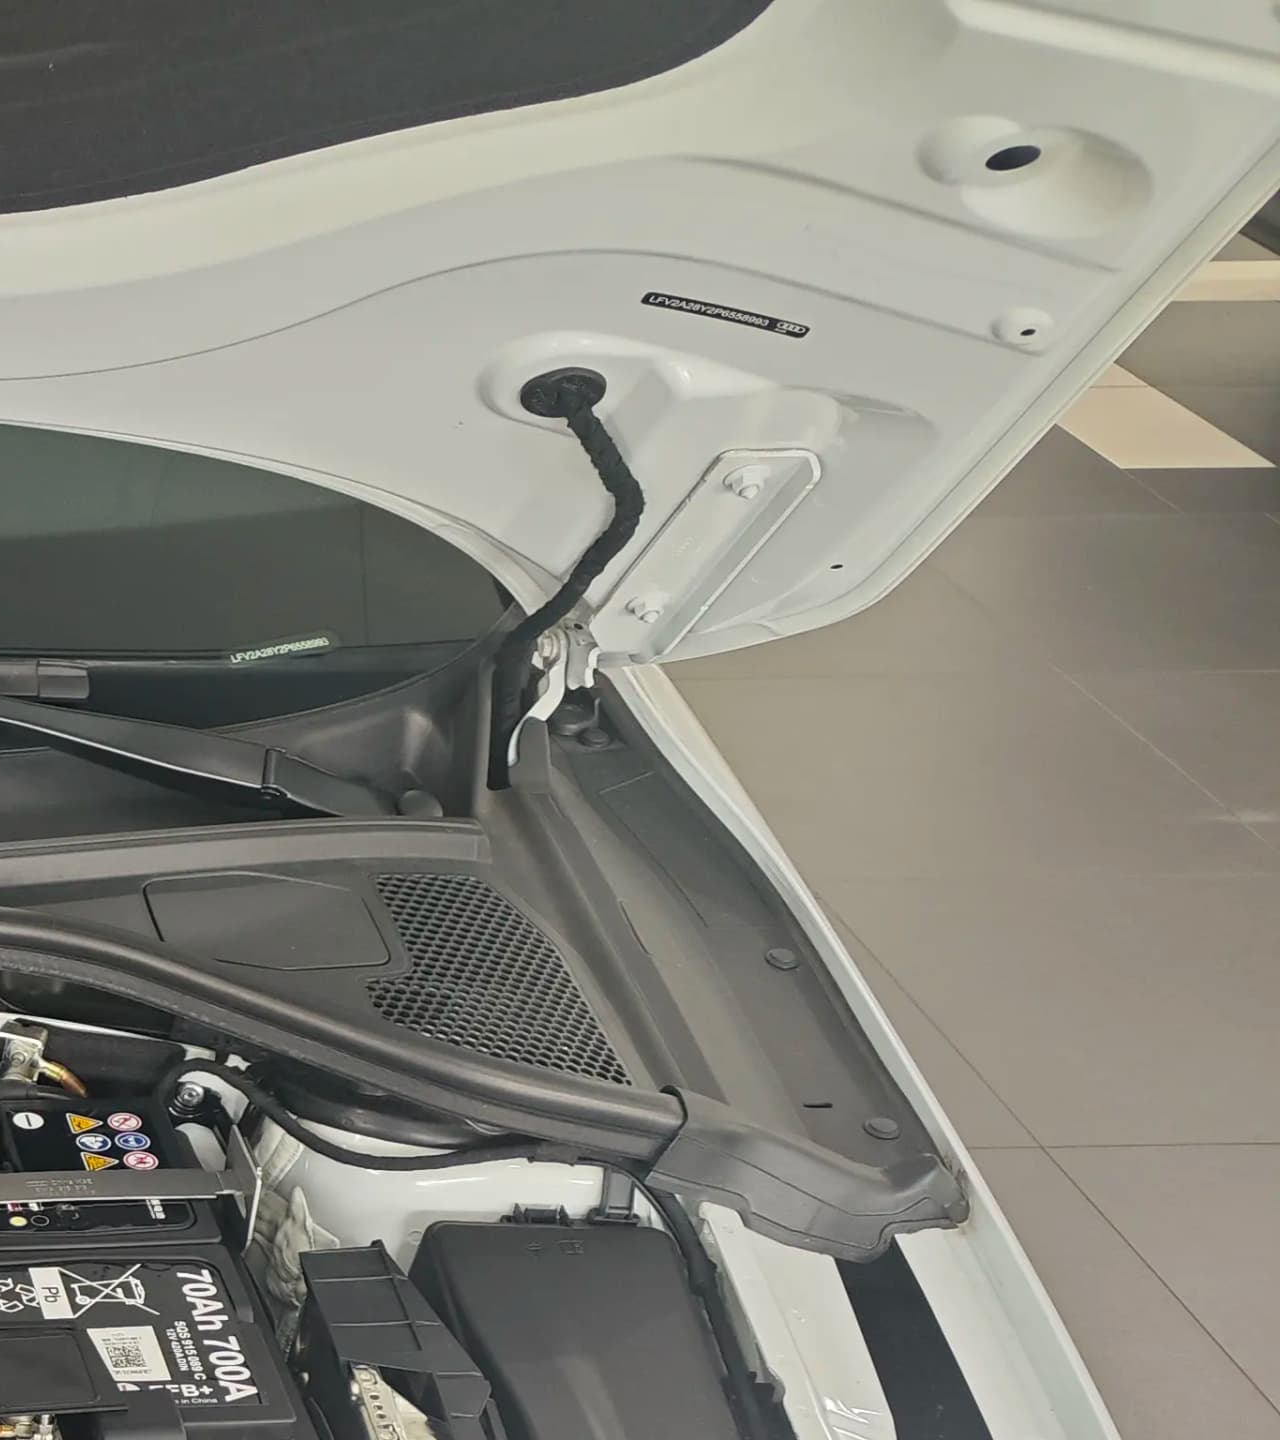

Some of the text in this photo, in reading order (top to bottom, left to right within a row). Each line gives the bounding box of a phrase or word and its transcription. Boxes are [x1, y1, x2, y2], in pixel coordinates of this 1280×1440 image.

[39, 1285, 59, 1304] Pb
[176, 1269, 258, 1403] 70Ah 700A
[181, 1340, 197, 1355] 915
